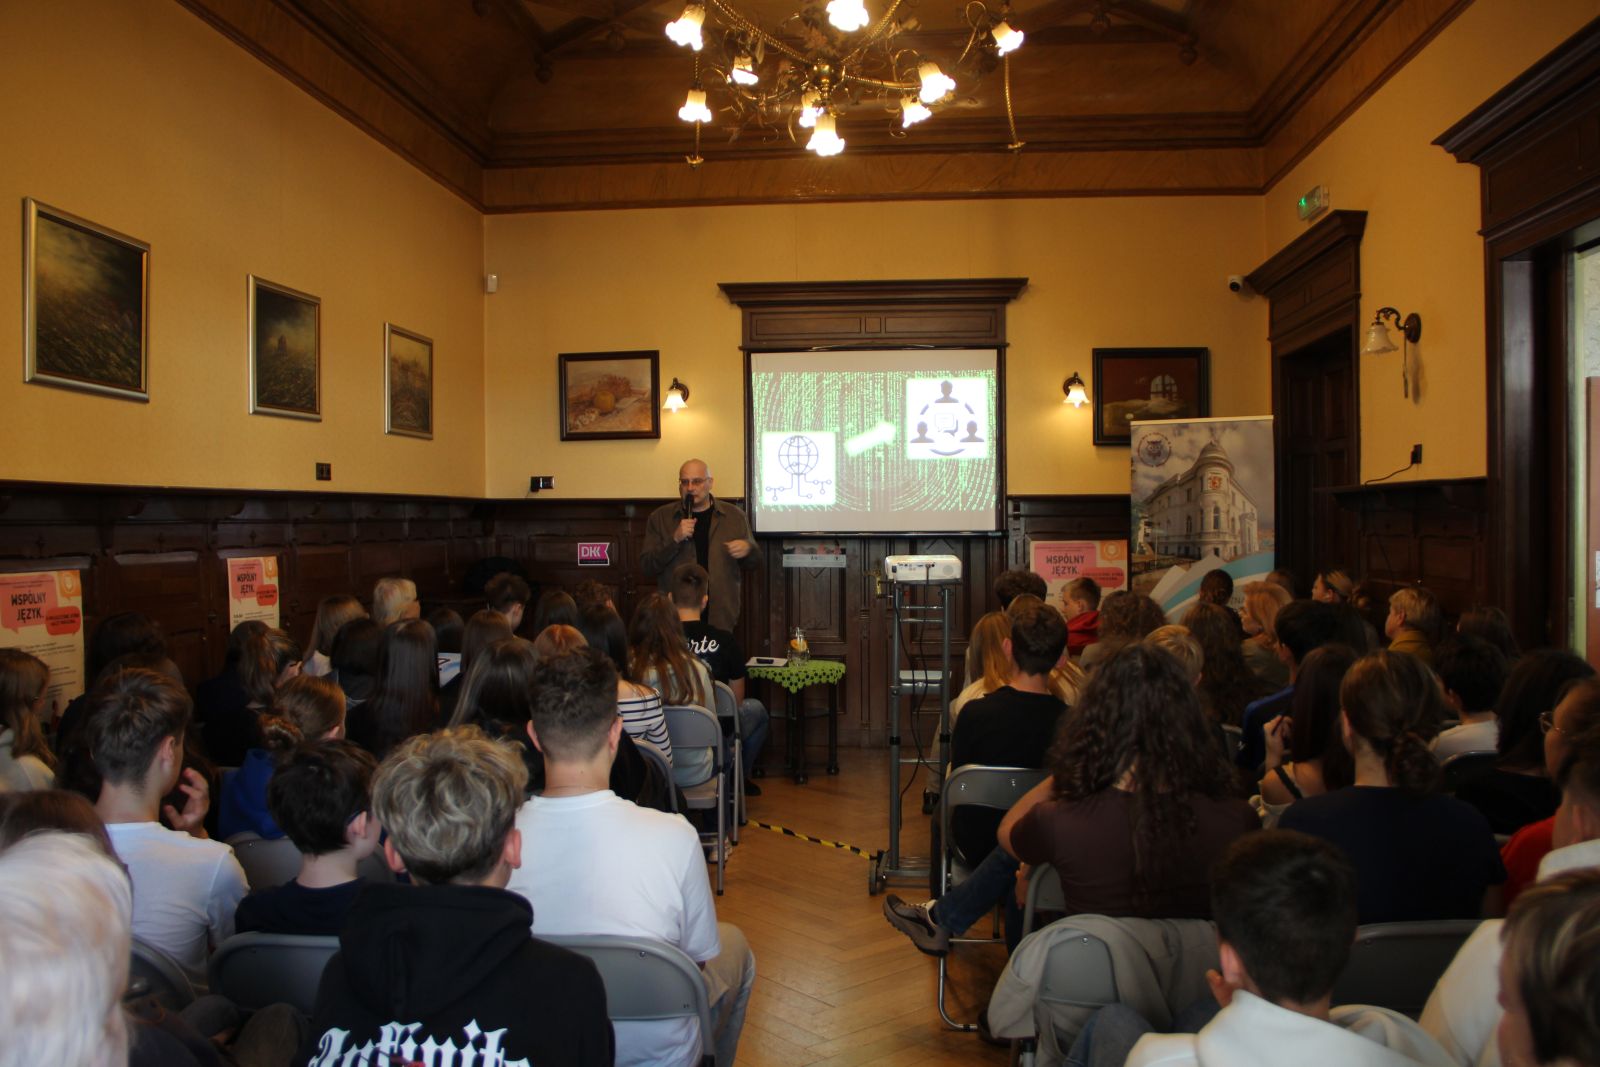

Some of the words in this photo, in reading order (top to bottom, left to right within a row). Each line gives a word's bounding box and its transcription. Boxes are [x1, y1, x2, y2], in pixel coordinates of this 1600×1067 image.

[1046, 553, 1085, 564] WSPÓLNY
[11, 590, 46, 606] WSPÓLNY
[687, 635, 720, 654] rte
[308, 1018, 530, 1067] Infinit
